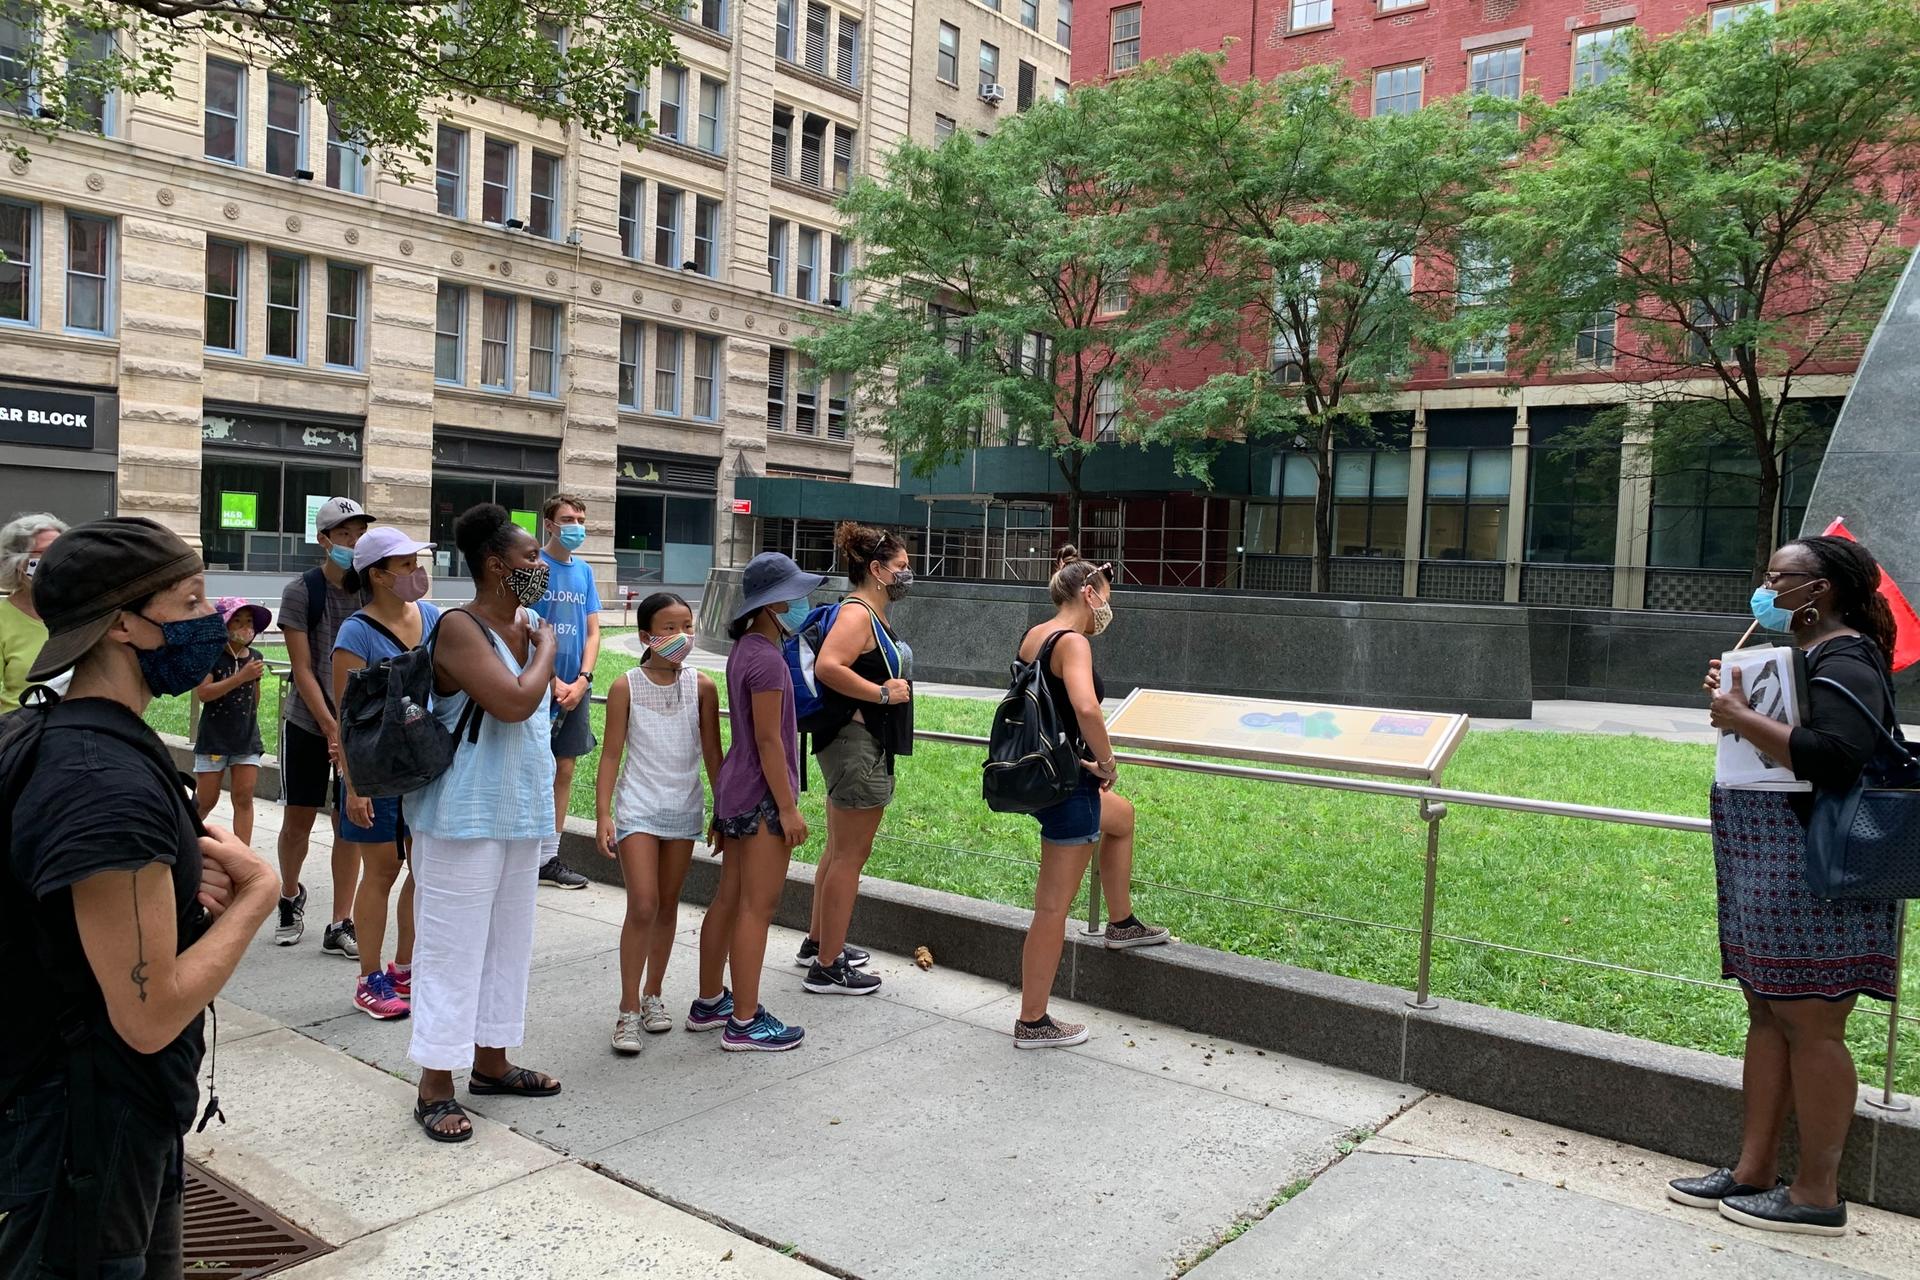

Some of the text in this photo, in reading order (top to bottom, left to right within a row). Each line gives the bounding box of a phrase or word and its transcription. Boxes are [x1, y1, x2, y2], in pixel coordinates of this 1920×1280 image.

[27, 410, 87, 427] BLOCK
[339, 501, 355, 513] NY
[223, 510, 243, 519] H&R
[223, 519, 253, 527] BLOCK
[539, 590, 585, 604] OLORAD
[554, 623, 577, 635] 1876
